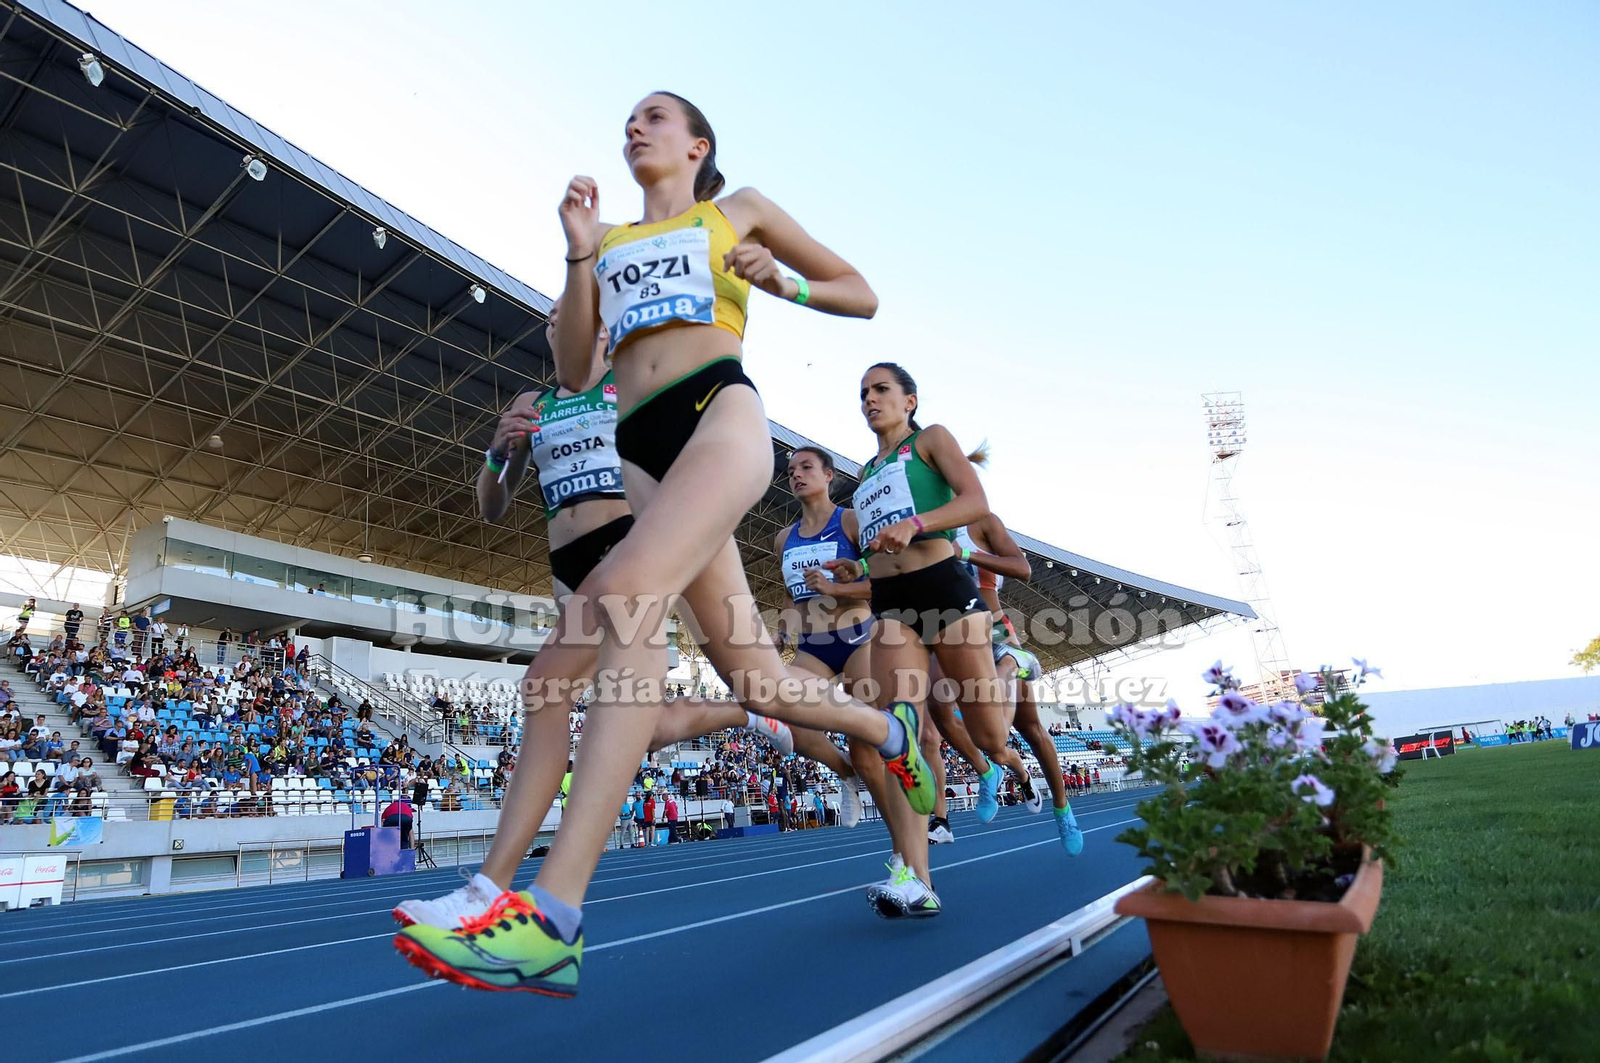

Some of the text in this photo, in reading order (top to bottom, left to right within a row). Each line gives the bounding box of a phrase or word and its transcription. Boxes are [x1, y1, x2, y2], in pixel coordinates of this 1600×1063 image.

[607, 254, 691, 293] TOZZI
[639, 282, 661, 299] 83
[551, 436, 604, 460] COSTA
[570, 460, 587, 473] 37
[859, 485, 891, 511] CAMPO
[870, 507, 882, 520] 25
[791, 558, 821, 570] SILVA
